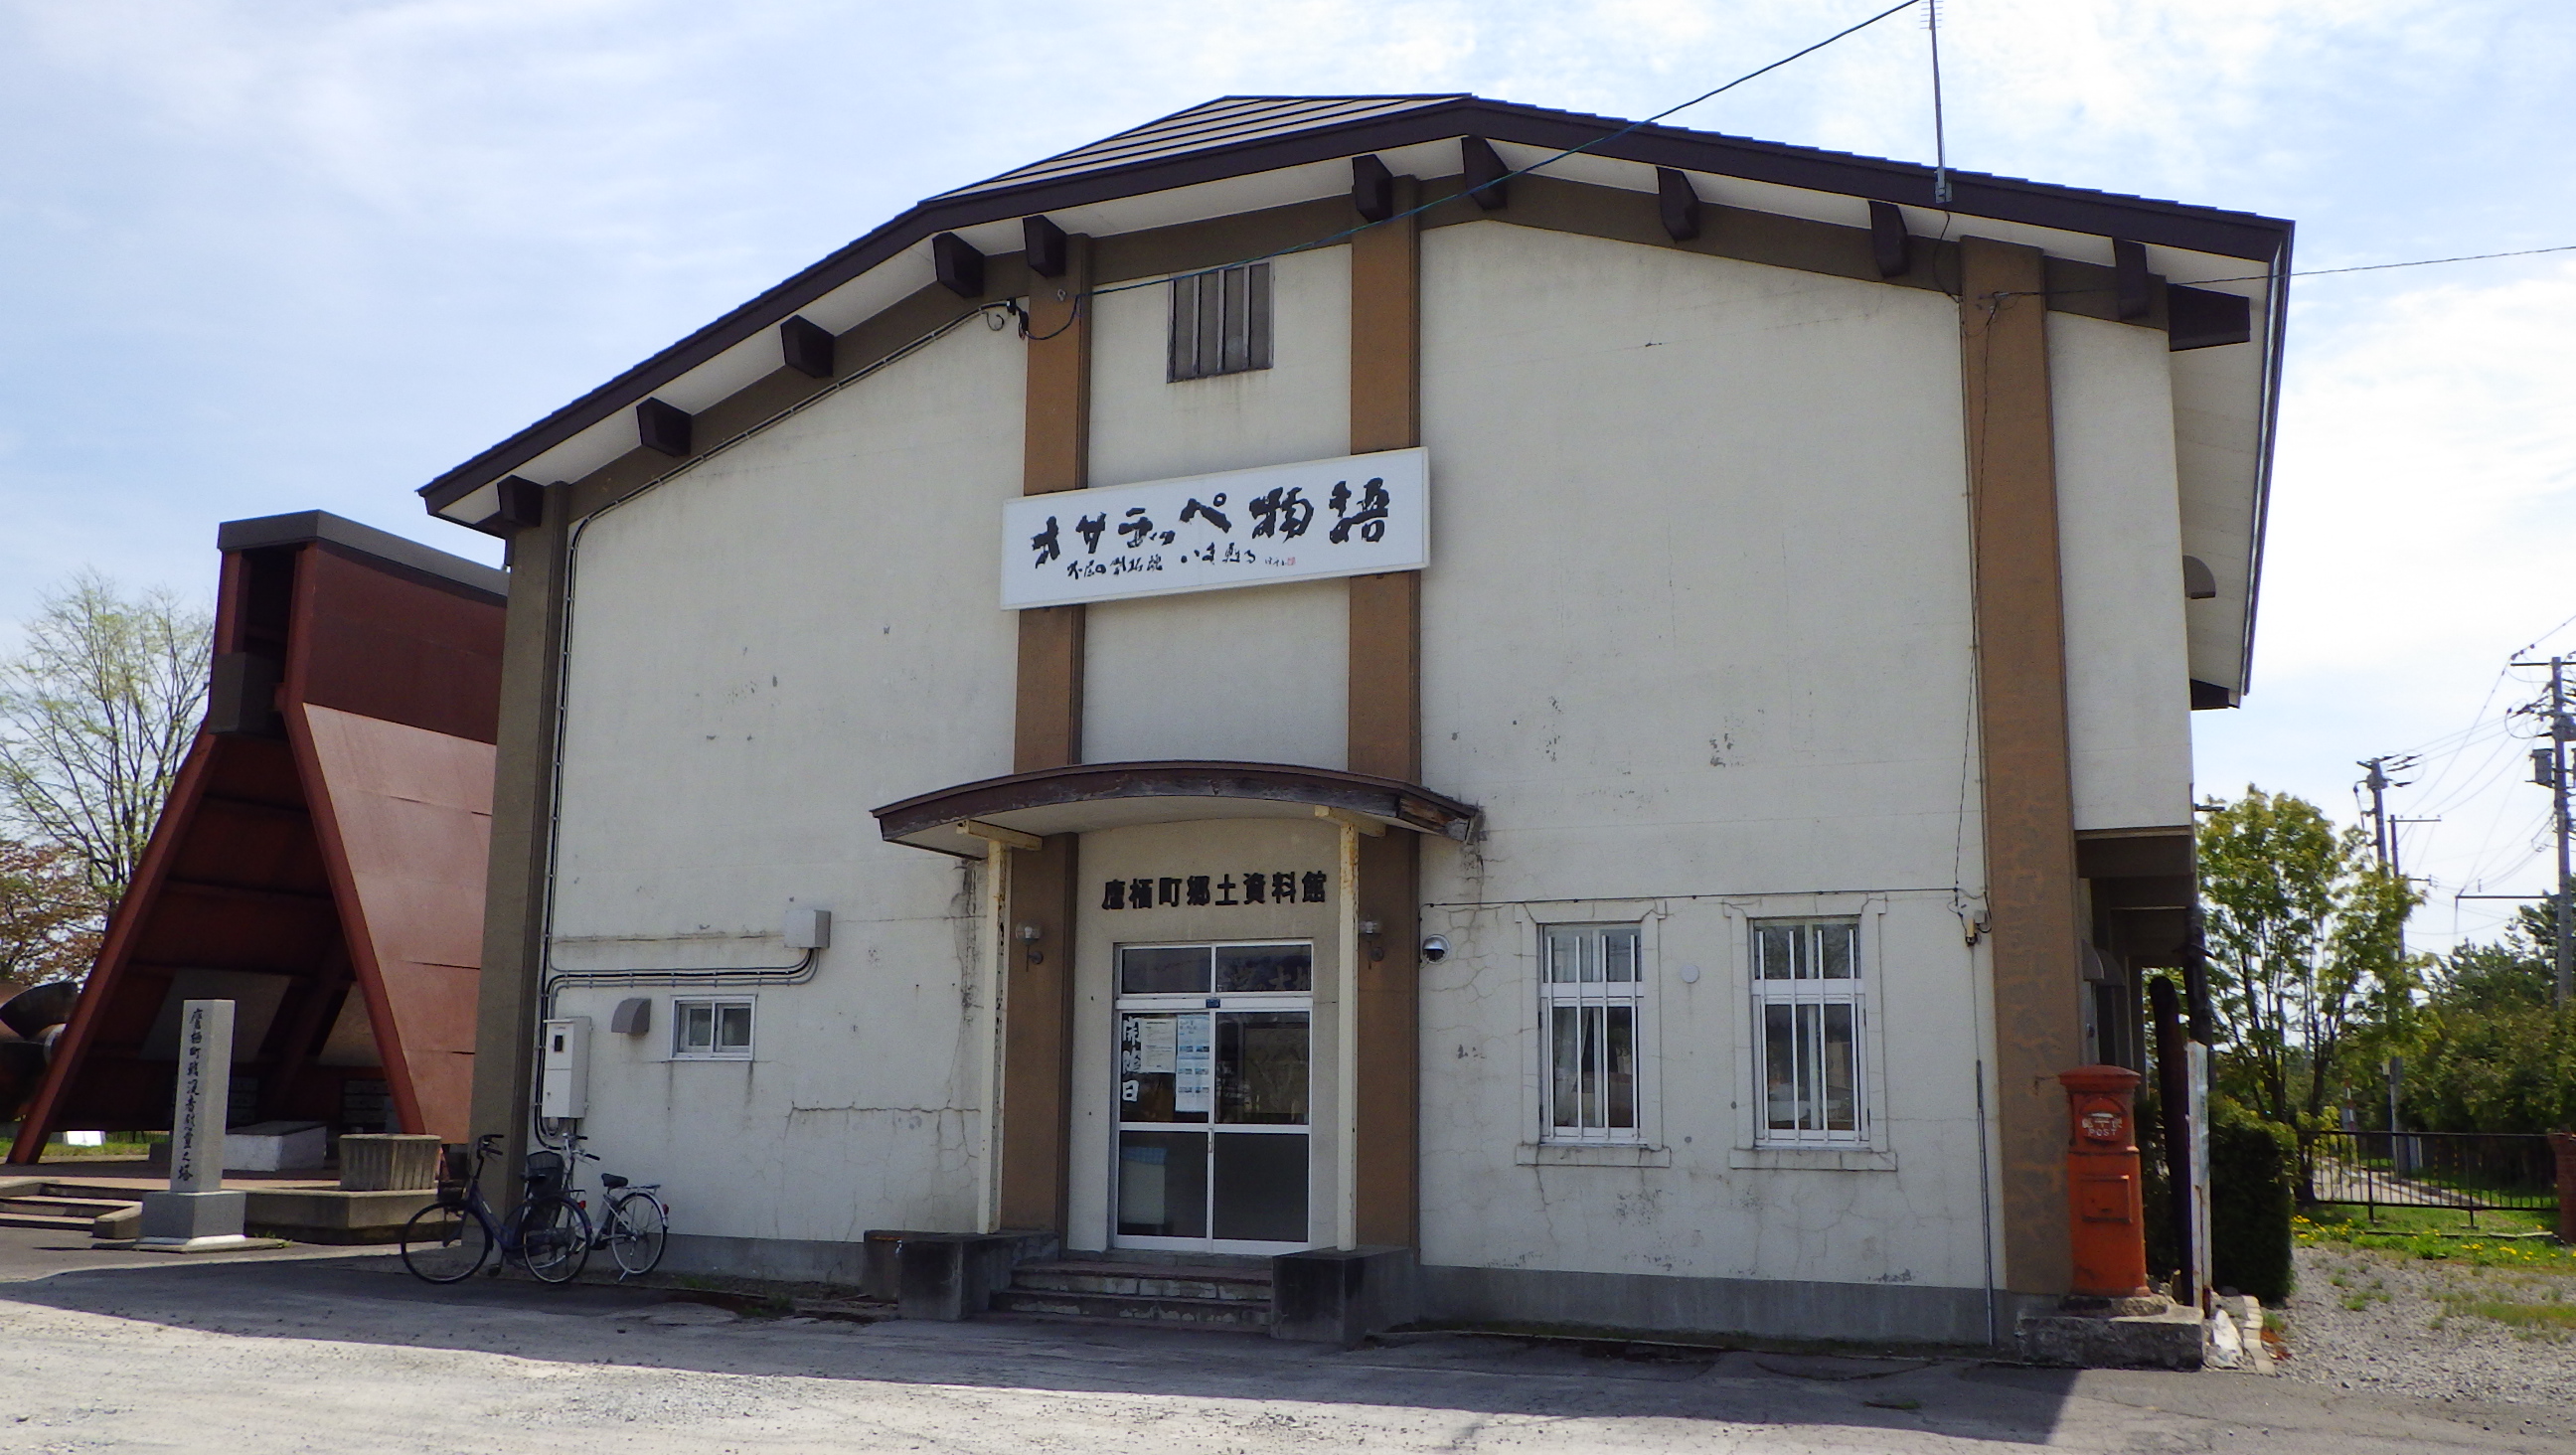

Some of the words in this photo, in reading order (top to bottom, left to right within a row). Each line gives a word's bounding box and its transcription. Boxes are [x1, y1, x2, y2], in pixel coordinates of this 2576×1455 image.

[1102, 871, 1327, 910] 鷹栖町郷土資料館
[2088, 1128, 2117, 1137] POST
